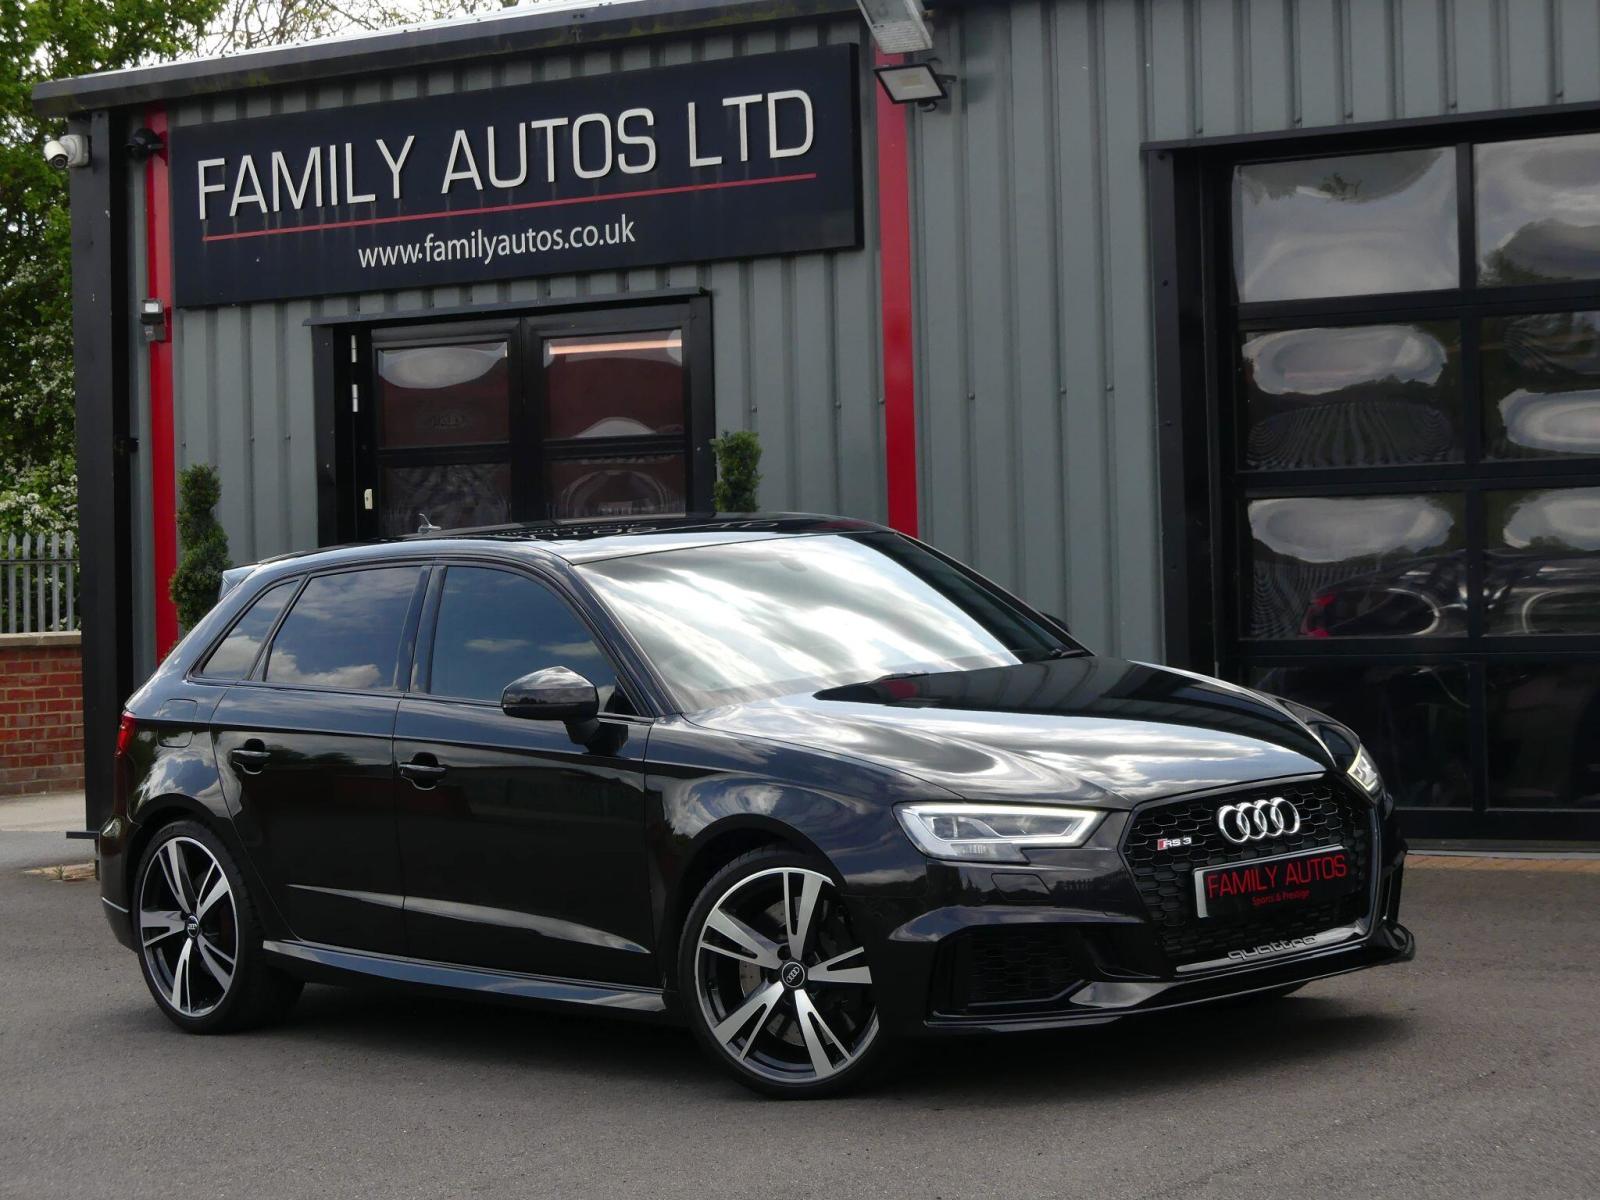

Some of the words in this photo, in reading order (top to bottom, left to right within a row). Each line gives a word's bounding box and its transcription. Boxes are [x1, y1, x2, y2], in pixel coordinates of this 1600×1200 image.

[197, 134, 416, 220] FAMILY
[441, 107, 656, 193] AUTOS
[688, 88, 816, 168] LTD
[358, 214, 636, 269] www.familyautos.co.uk
[1206, 865, 1278, 898] FAMILY
[1285, 855, 1348, 885] AUTOS
[1228, 935, 1318, 961] quattro
